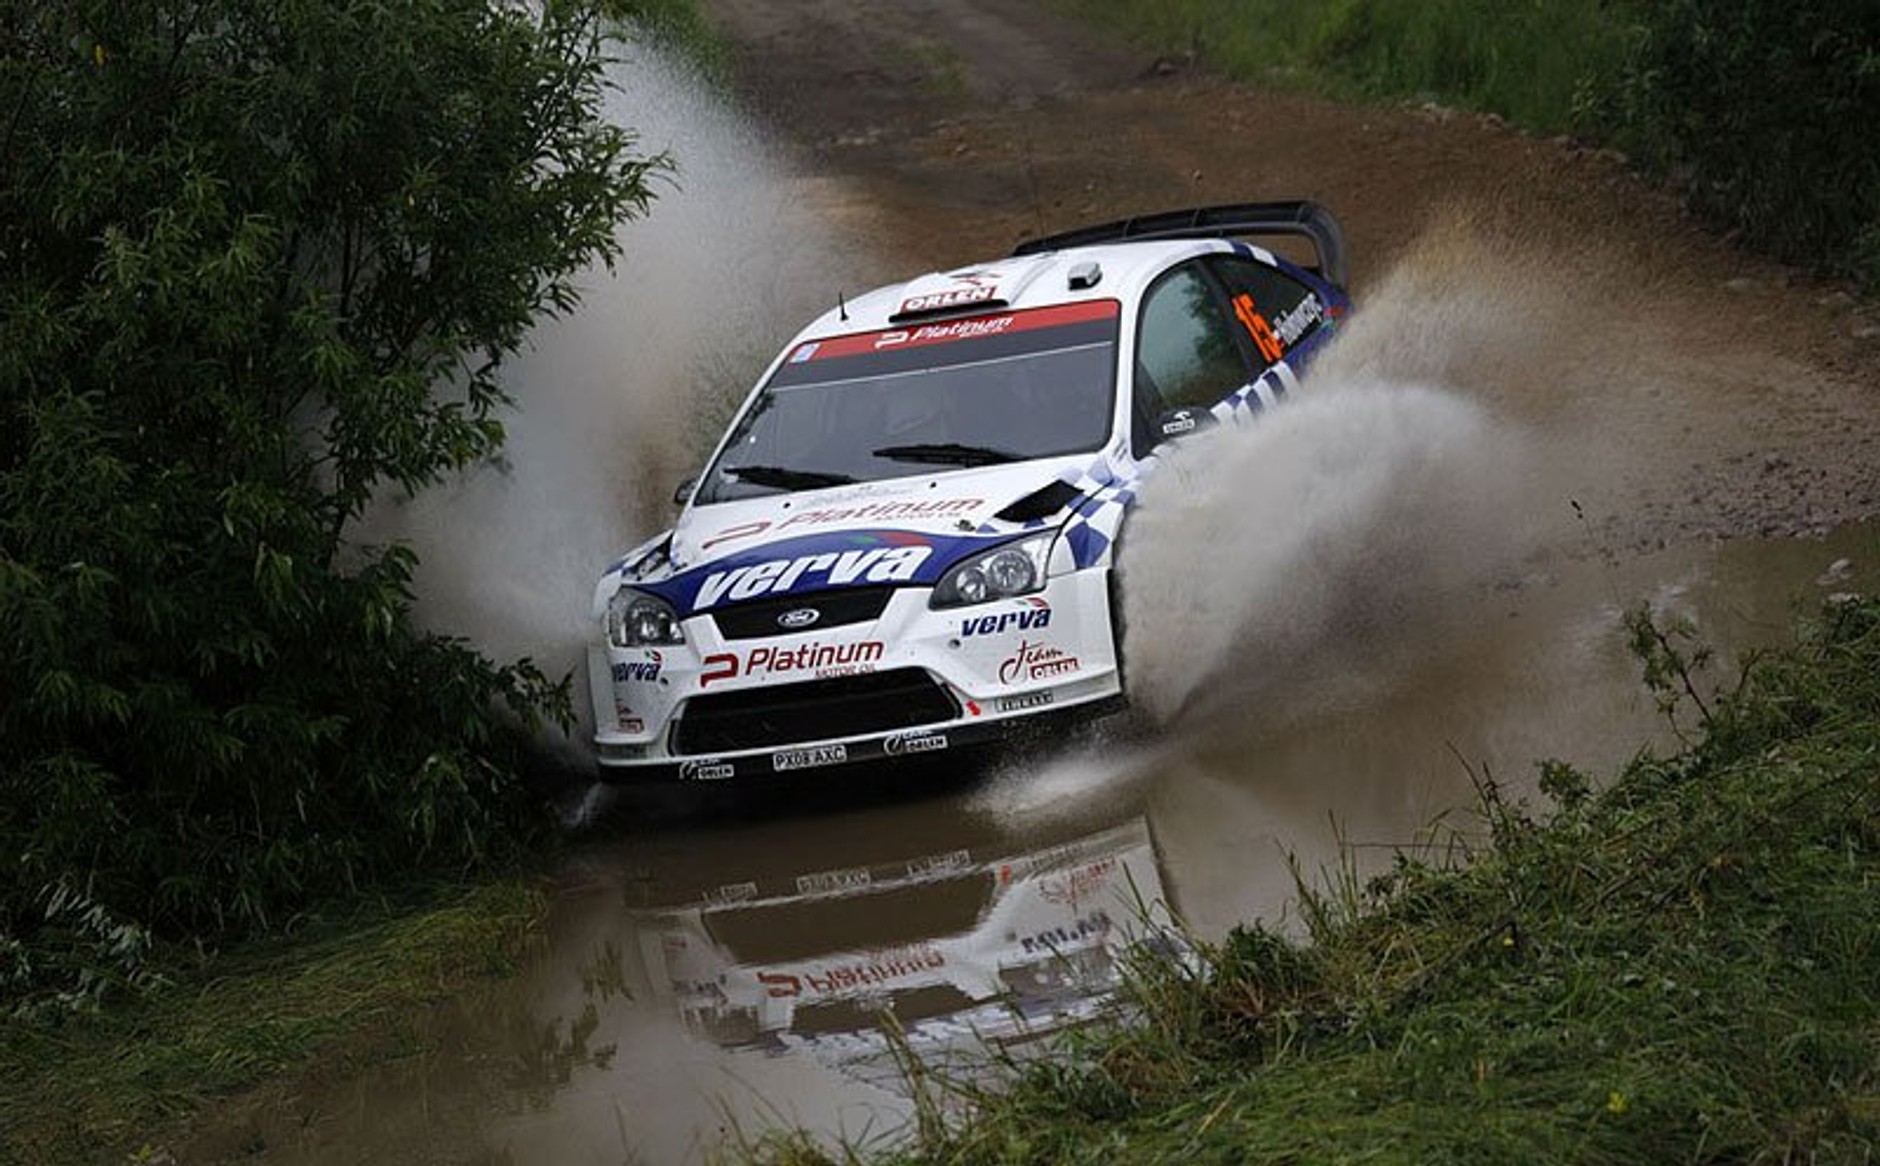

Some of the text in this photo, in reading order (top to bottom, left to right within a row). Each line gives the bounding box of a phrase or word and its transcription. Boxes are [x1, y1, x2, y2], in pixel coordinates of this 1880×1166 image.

[905, 286, 991, 312] ORLEN
[910, 317, 1014, 342] Platinum
[777, 499, 985, 529] Platinum
[692, 546, 933, 611] verva
[961, 609, 1051, 637] verva
[745, 641, 884, 676] Platinum
